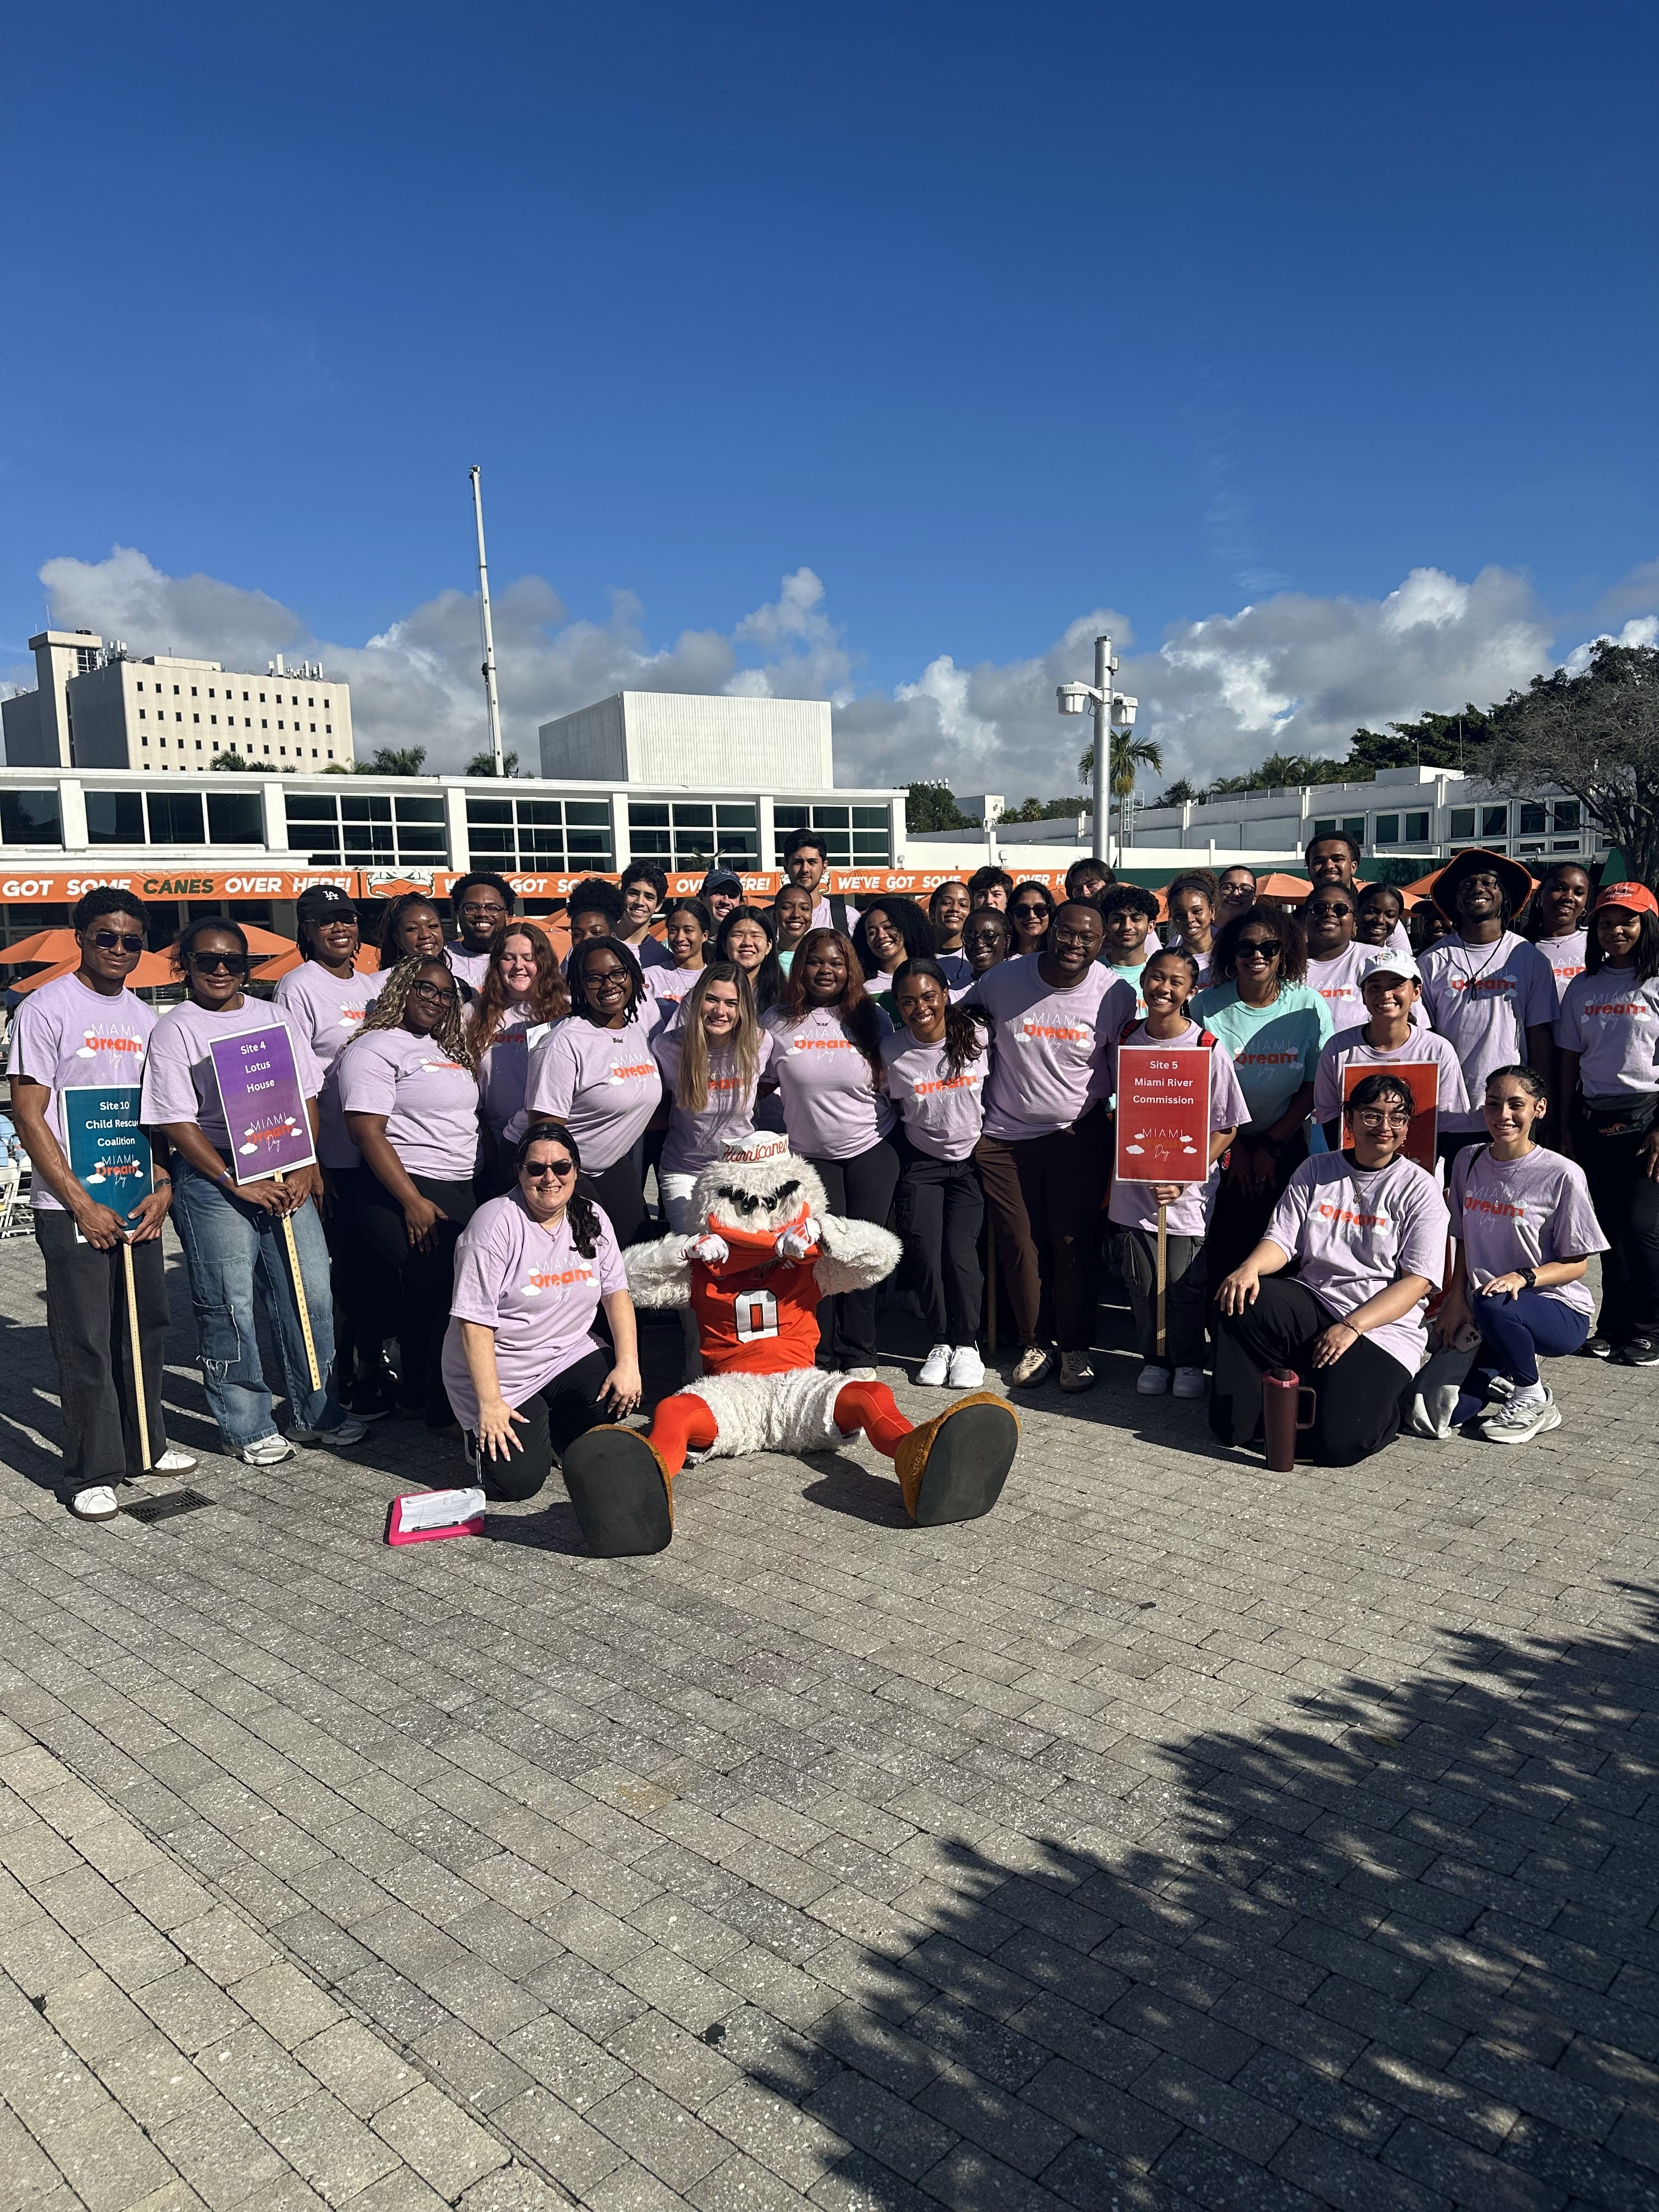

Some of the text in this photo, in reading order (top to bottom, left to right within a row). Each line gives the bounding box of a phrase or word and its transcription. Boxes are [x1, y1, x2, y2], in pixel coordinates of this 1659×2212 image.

[2, 880, 53, 896] GOT
[143, 879, 214, 894] CANES
[225, 878, 281, 894] OVER
[510, 878, 548, 893] GOT
[676, 878, 770, 893] OV ERE!
[838, 876, 880, 889] WE'VE
[887, 876, 916, 888] GOT
[1016, 874, 1050, 885] OVER
[322, 890, 340, 901] LA
[1452, 979, 1515, 991] Deam
[343, 1001, 367, 1009] MIA
[1584, 1003, 1645, 1016] Dream
[343, 1011, 366, 1019] Dre
[1032, 1012, 1081, 1026] MIAMI
[92, 1022, 136, 1036] MIAMI
[1024, 1024, 1086, 1040] Dream
[85, 1036, 142, 1052] Dream
[495, 1034, 525, 1043] Dre
[1045, 1034, 1063, 1054] Day
[1244, 1040, 1290, 1052] MIAMI
[240, 1041, 266, 1054] Site 4
[817, 1045, 836, 1063] Day
[110, 1045, 123, 1068] Day
[614, 1052, 645, 1066] MIAMI
[1235, 1052, 1297, 1065] Dream
[245, 1060, 271, 1074] Lotus
[613, 1064, 656, 1079] Dream
[1150, 1060, 1178, 1069] Site 5
[1257, 1059, 1277, 1080] Day
[246, 1079, 275, 1093] House
[634, 1072, 647, 1091] Day
[915, 1075, 977, 1095] Dream
[1135, 1078, 1193, 1087] Miami River
[937, 1086, 957, 1104] Day
[1133, 1095, 1194, 1104] Commission
[99, 1101, 129, 1110] Site 10
[86, 1119, 113, 1129] Child
[250, 1111, 286, 1131] MIAMI
[247, 1124, 295, 1144] Dream
[1142, 1128, 1183, 1138] MIAMI
[97, 1137, 135, 1147] Coalition
[266, 1134, 281, 1152] Day
[723, 1139, 788, 1163] Hurricanes
[1154, 1144, 1171, 1162] Day
[102, 1154, 134, 1165] MIAMI
[95, 1166, 139, 1176] Dream
[115, 1171, 127, 1188] Day
[1464, 1197, 1524, 1217] Dream
[1319, 1204, 1385, 1227] Dream
[1480, 1207, 1498, 1232] Day
[535, 1255, 583, 1273] MIAMI
[529, 1268, 594, 1289] Dream
[554, 1280, 573, 1302] Day
[734, 1289, 778, 1344] 0
